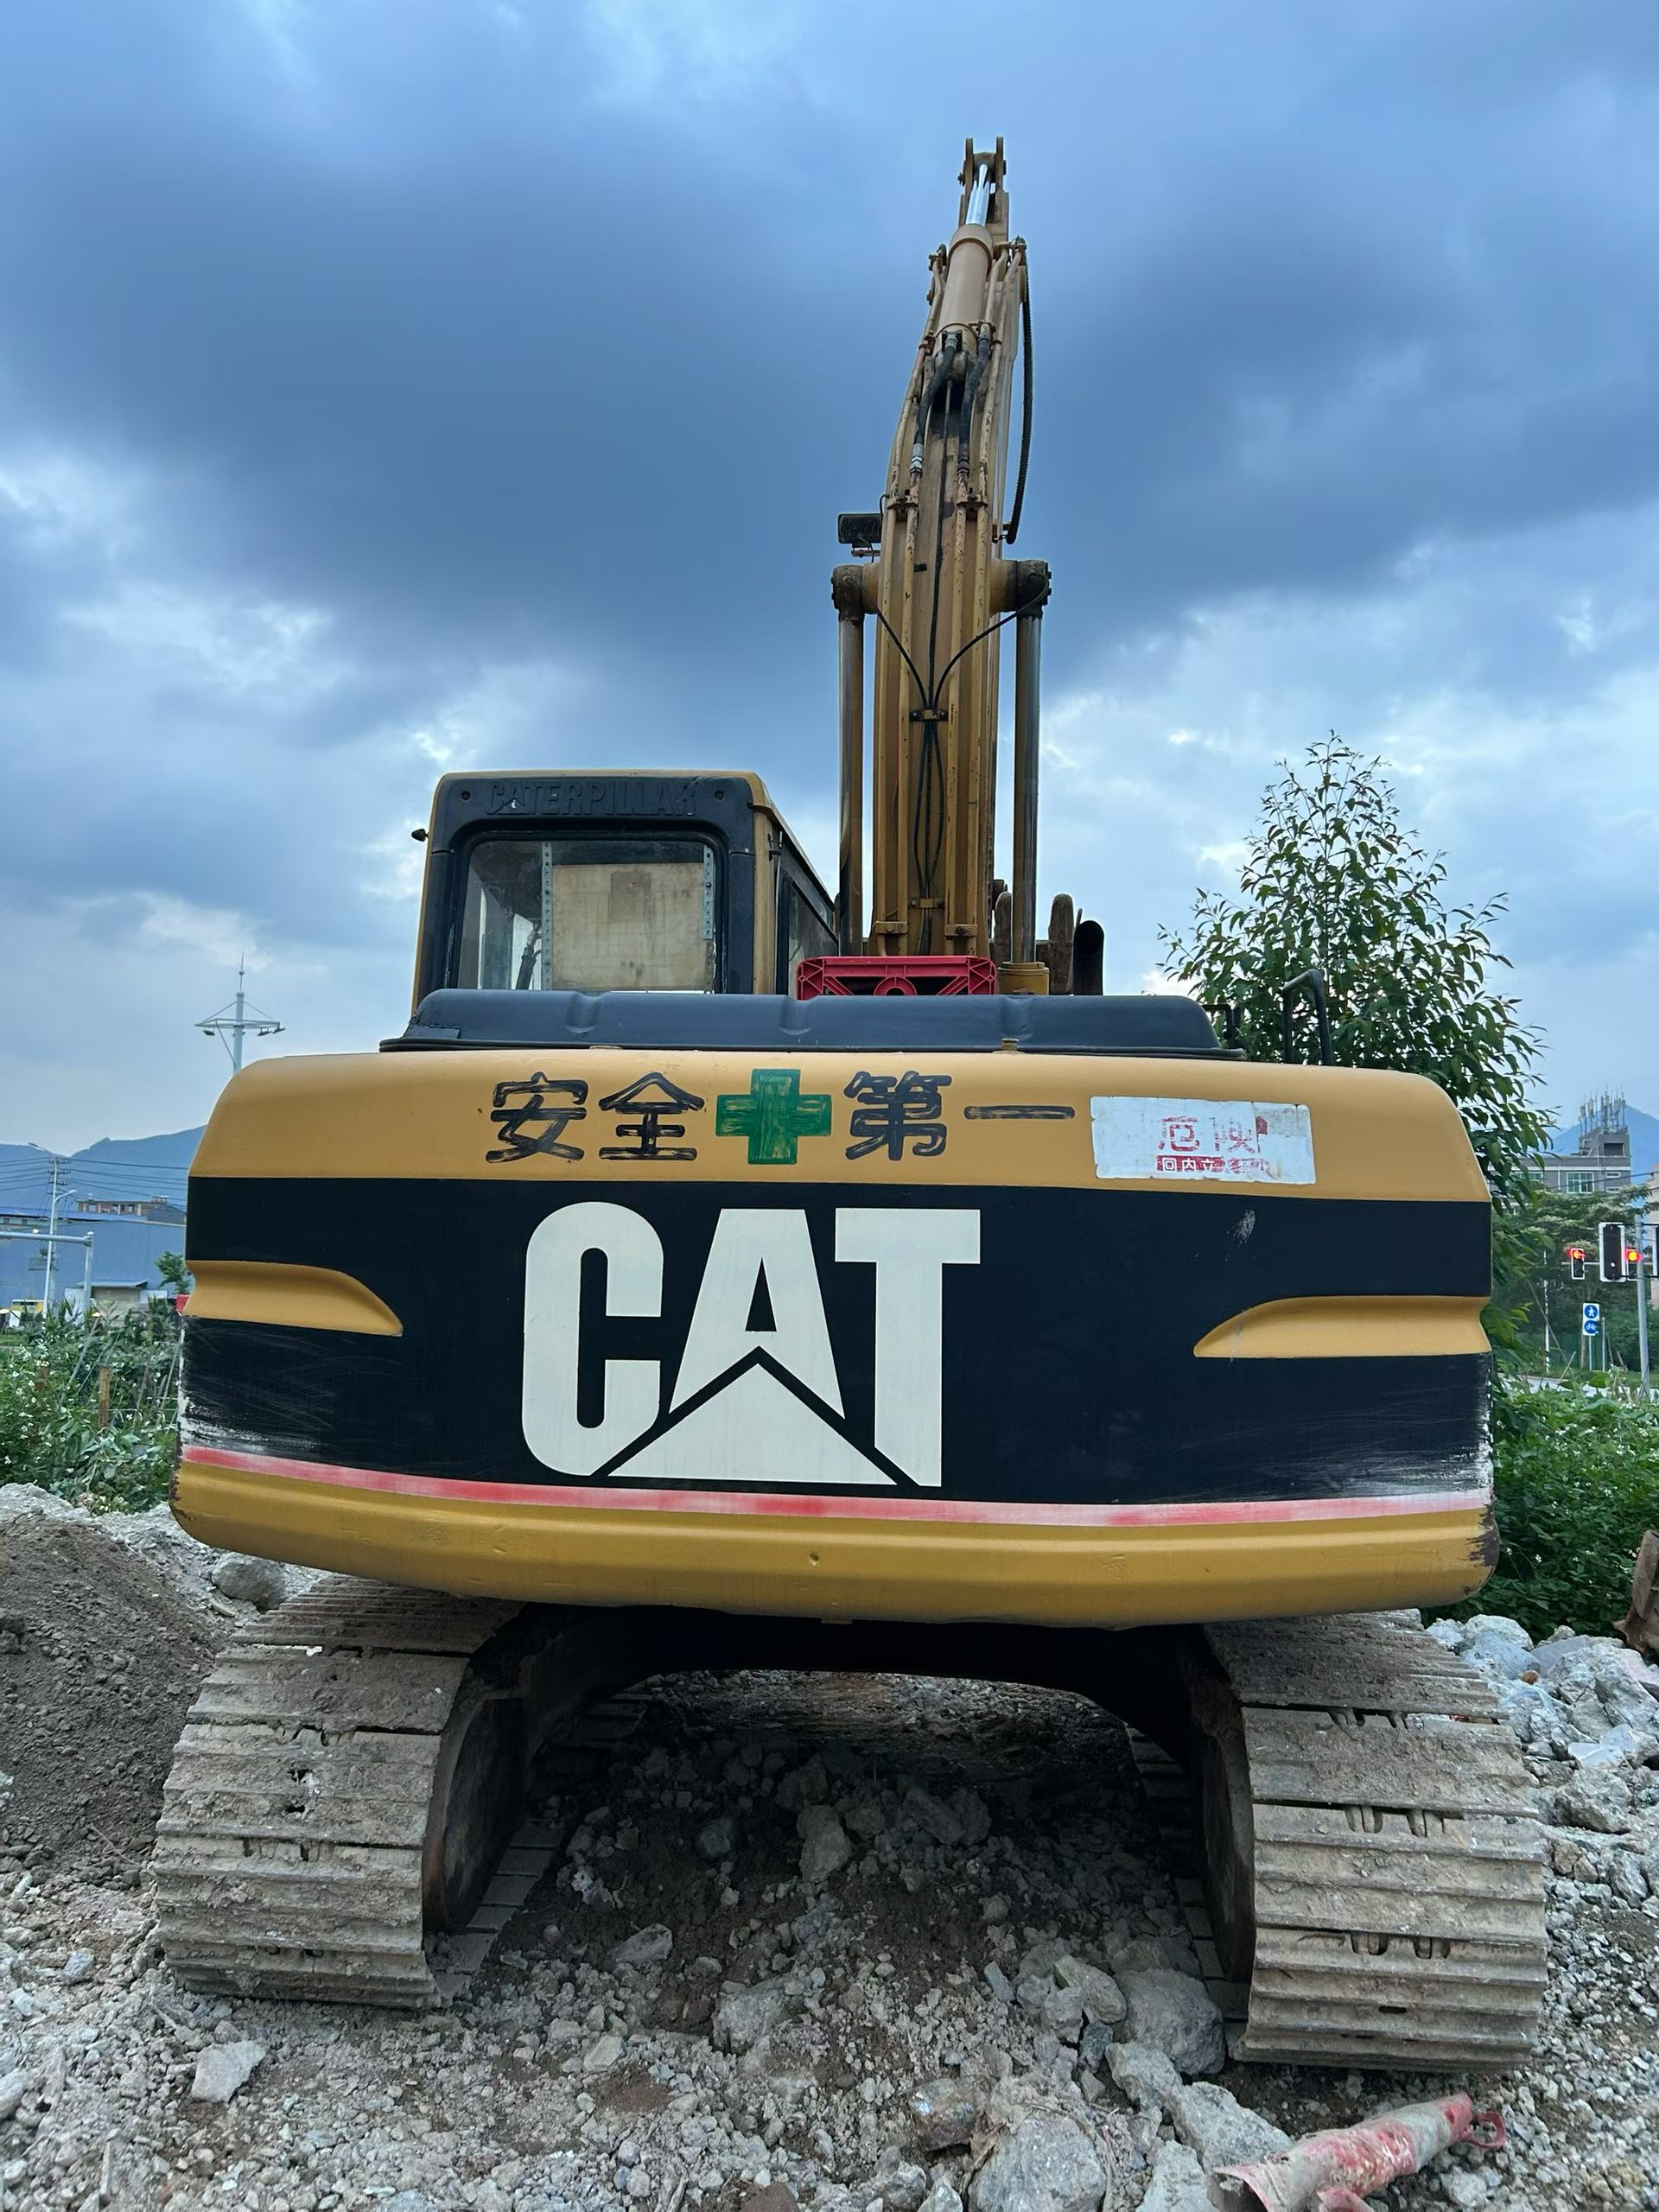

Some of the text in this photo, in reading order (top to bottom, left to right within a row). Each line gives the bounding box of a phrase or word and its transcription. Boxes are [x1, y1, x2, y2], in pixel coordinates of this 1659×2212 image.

[485, 779, 699, 816] CATERPILLAR
[485, 1071, 1076, 1163] 安全 第一
[521, 1201, 982, 1488] CAT
